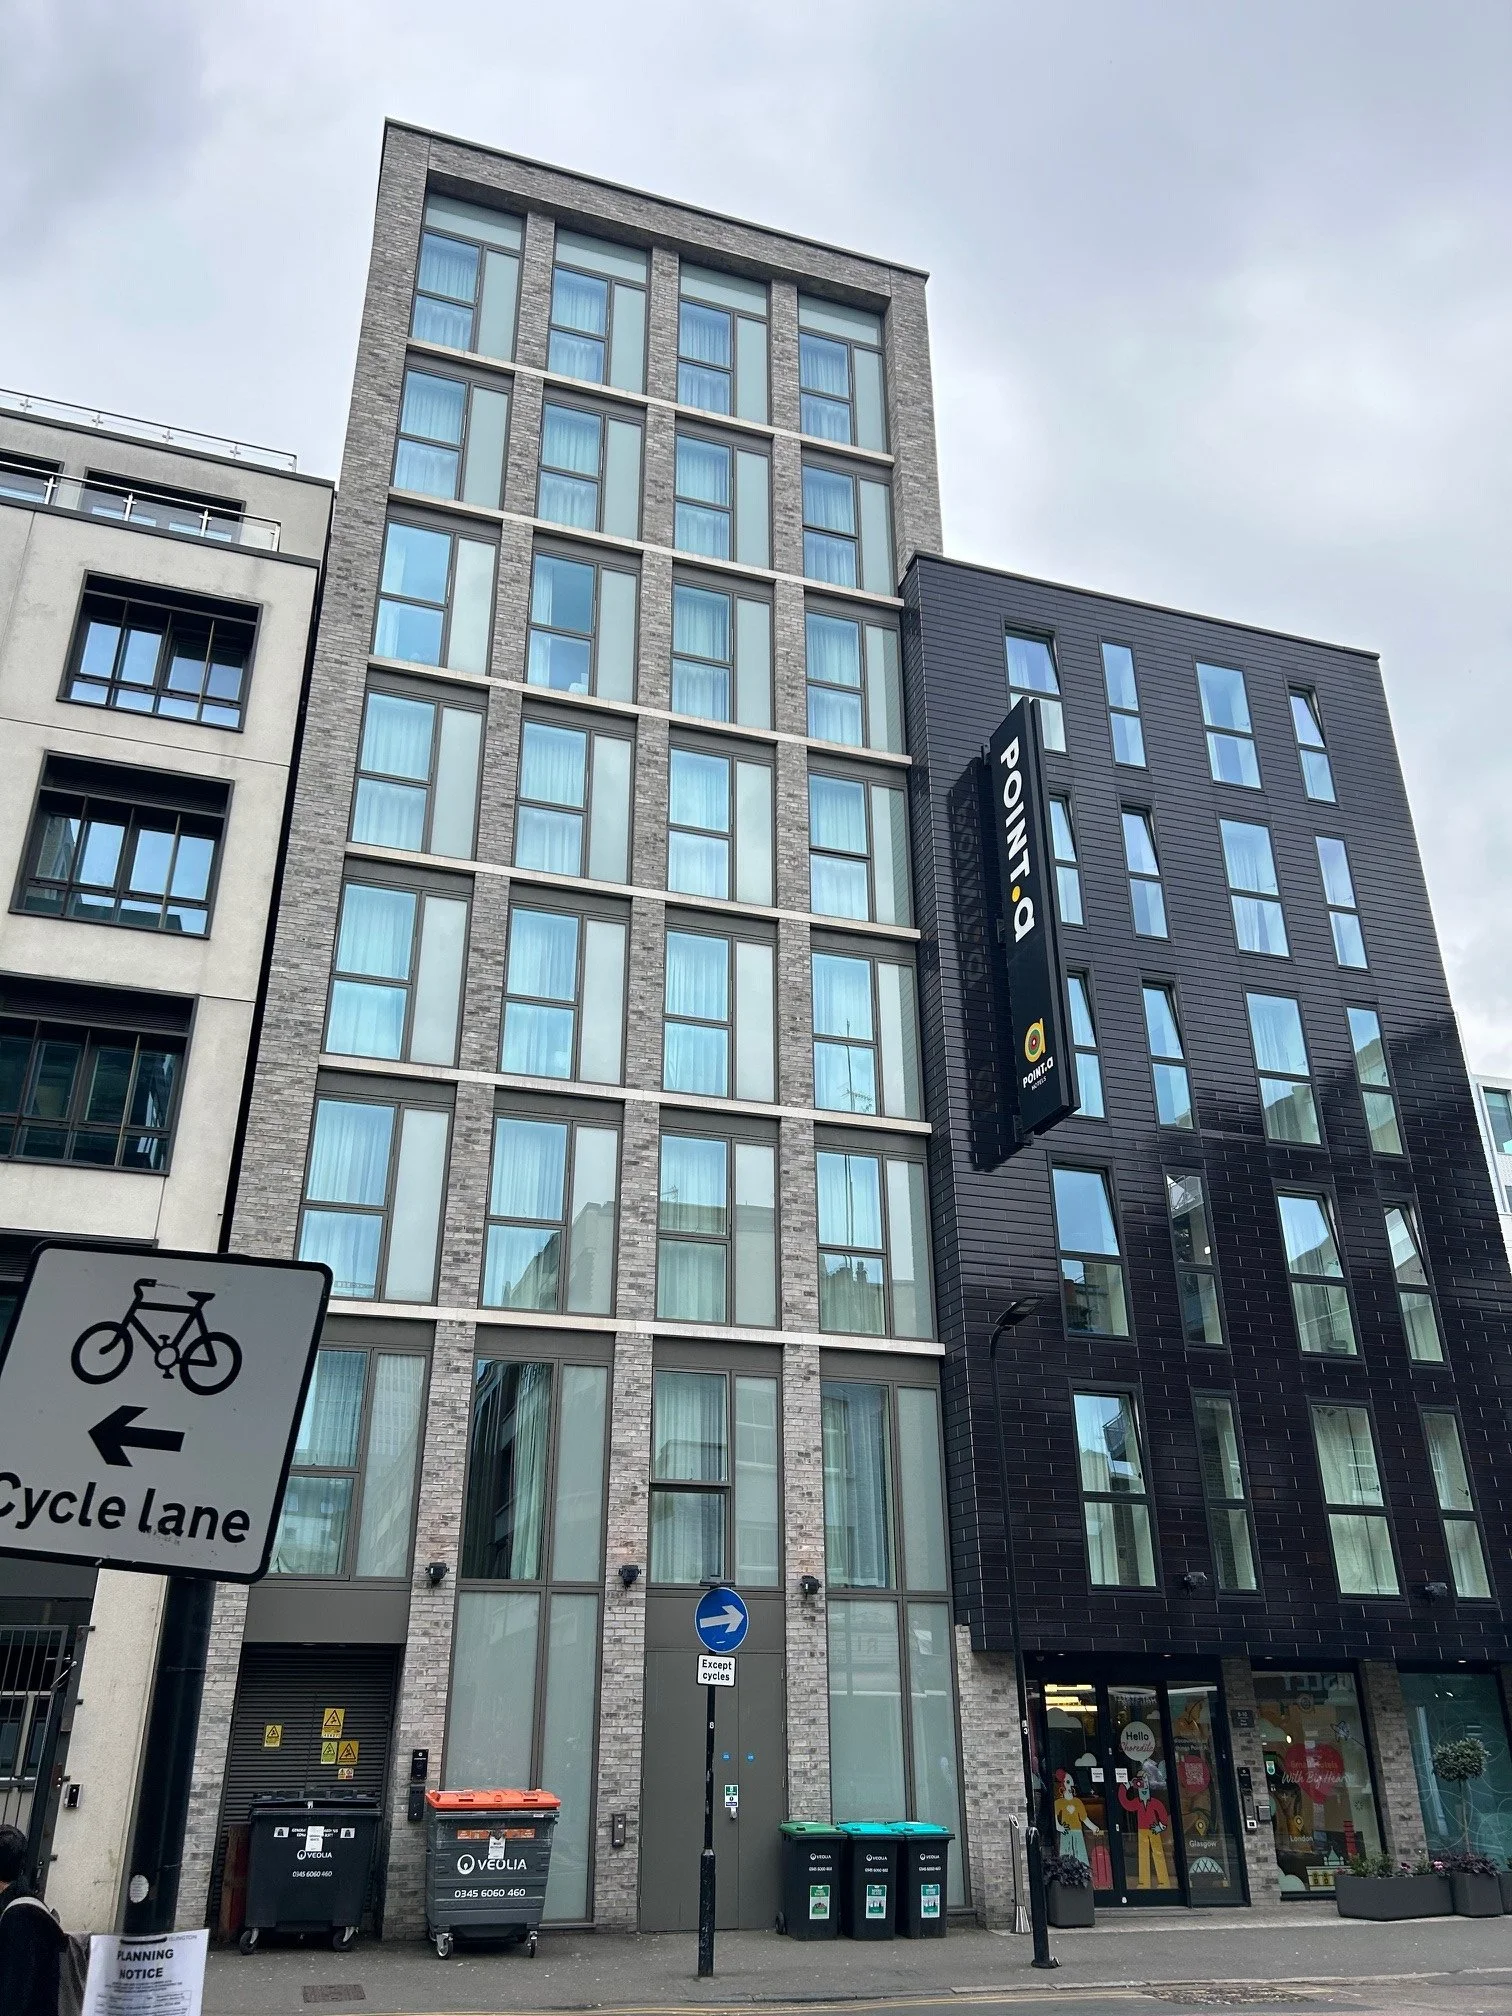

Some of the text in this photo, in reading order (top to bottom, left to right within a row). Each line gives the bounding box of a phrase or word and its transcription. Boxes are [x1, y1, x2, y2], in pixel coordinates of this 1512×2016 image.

[1031, 1075, 1047, 1091] HOTELS
[0, 1471, 250, 1543] Cycle lane
[702, 1659, 732, 1671] Except
[702, 1671, 730, 1681] cycles
[709, 1721, 715, 1729] 8
[1125, 1731, 1149, 1741] Hello
[1281, 1771, 1303, 1784] With
[1306, 1771, 1322, 1788] Big
[1189, 1839, 1217, 1848] Glasgow
[477, 1858, 527, 1871] VEOLIA
[454, 1888, 526, 1898] 0345 6060 460
[116, 1949, 174, 1961] PLANNING
[119, 1967, 164, 1979] NOTICE
